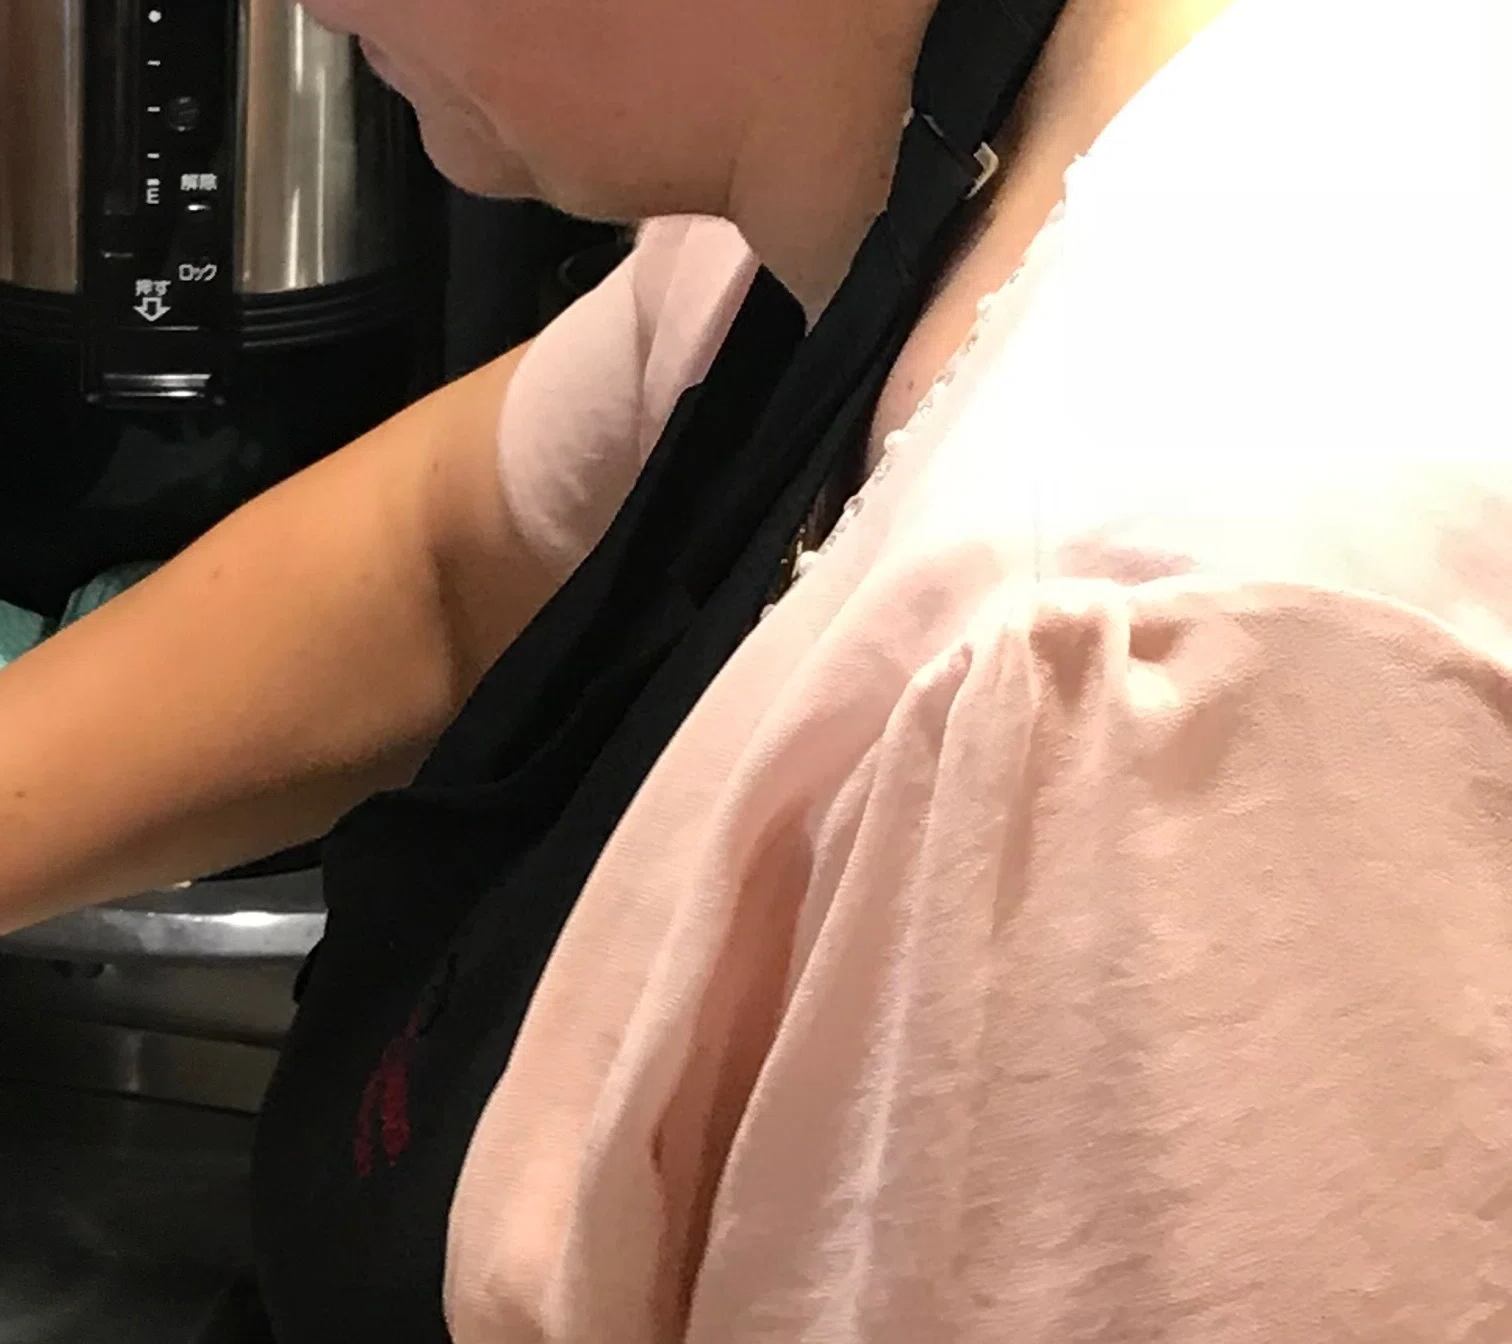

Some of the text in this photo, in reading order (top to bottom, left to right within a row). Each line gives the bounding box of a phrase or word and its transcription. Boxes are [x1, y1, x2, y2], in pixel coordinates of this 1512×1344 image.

[146, 188, 159, 204] E
[178, 264, 217, 281] ロック
[135, 279, 171, 296] 押す
